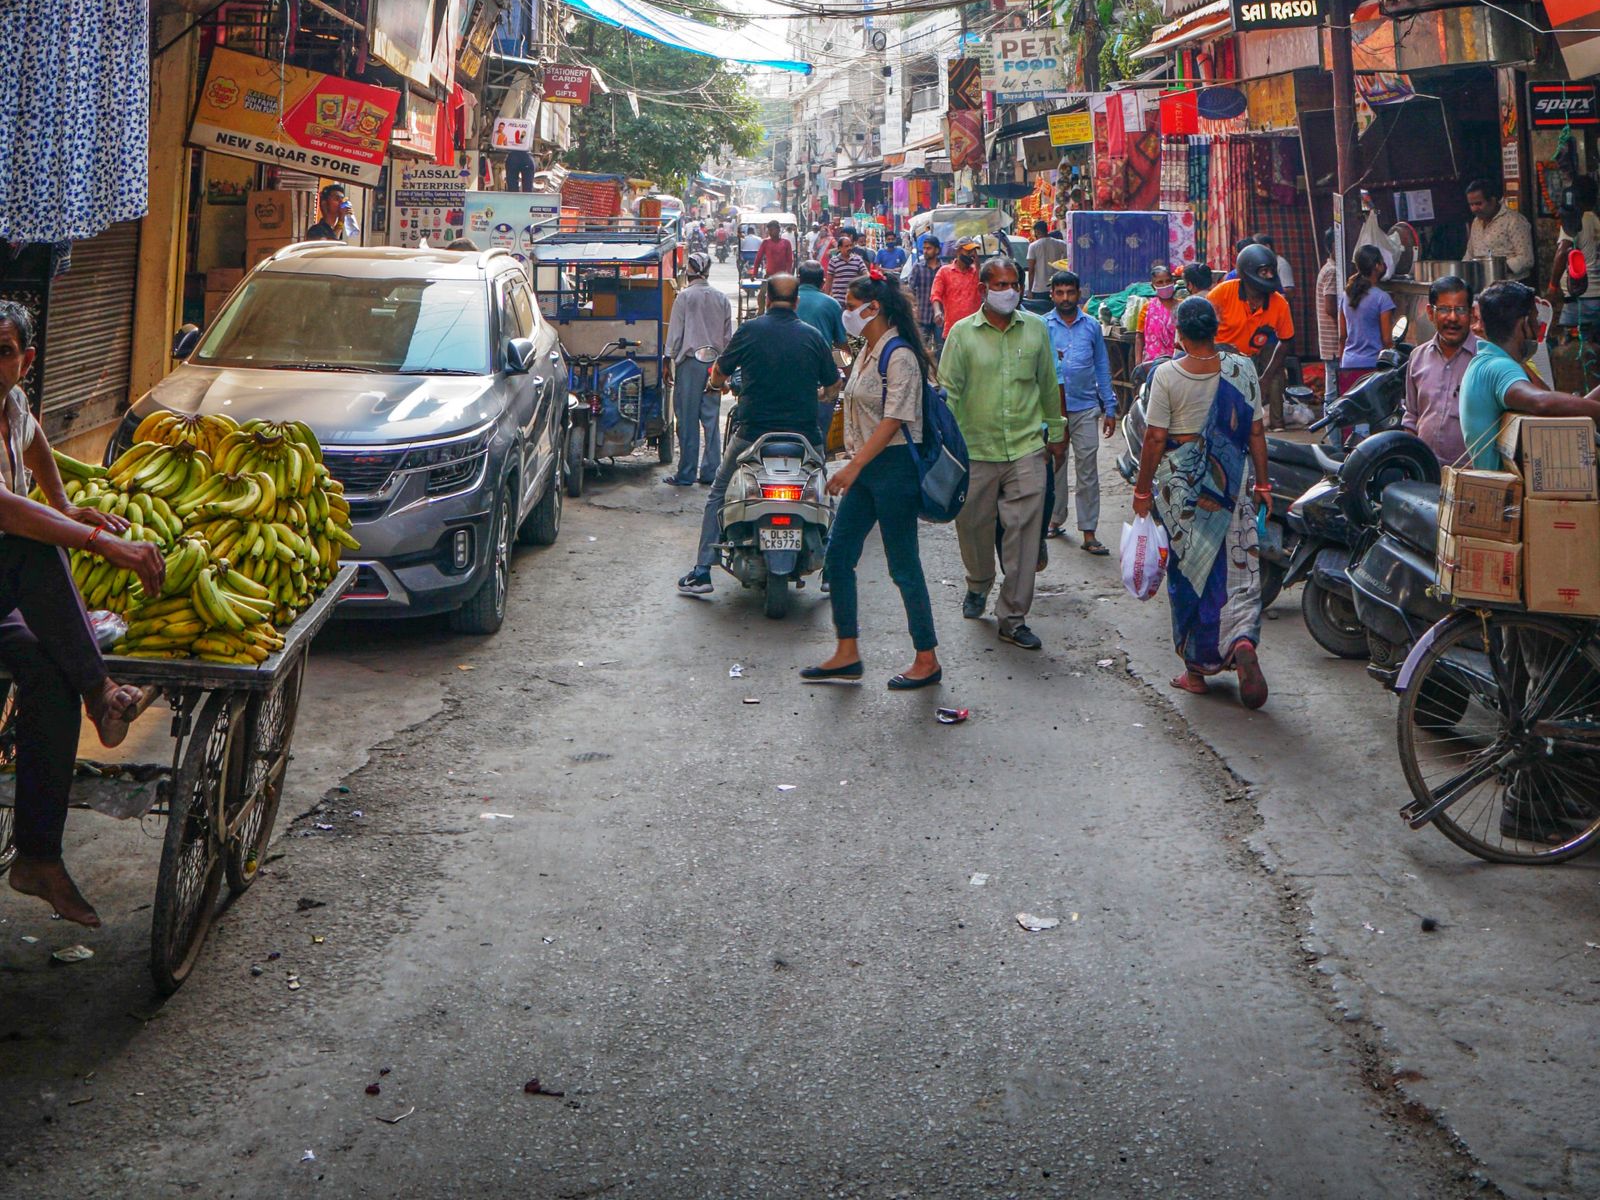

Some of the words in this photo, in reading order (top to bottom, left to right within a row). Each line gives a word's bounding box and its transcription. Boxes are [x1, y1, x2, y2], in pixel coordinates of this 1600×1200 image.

[1241, 3, 1266, 22] SAI
[1271, 0, 1318, 20] RASOI
[1001, 36, 1056, 59] PET
[1003, 58, 1057, 72] FOOD
[547, 68, 589, 77] STATIONERY
[1535, 98, 1590, 113] sparx
[215, 132, 252, 150] NEW
[254, 141, 306, 163] SAGAR
[310, 155, 361, 176] STORE
[412, 169, 459, 179] JASSAL
[402, 182, 466, 190] ENTERPRISE
[770, 530, 794, 539] DL3S
[764, 540, 800, 549] CK9776
